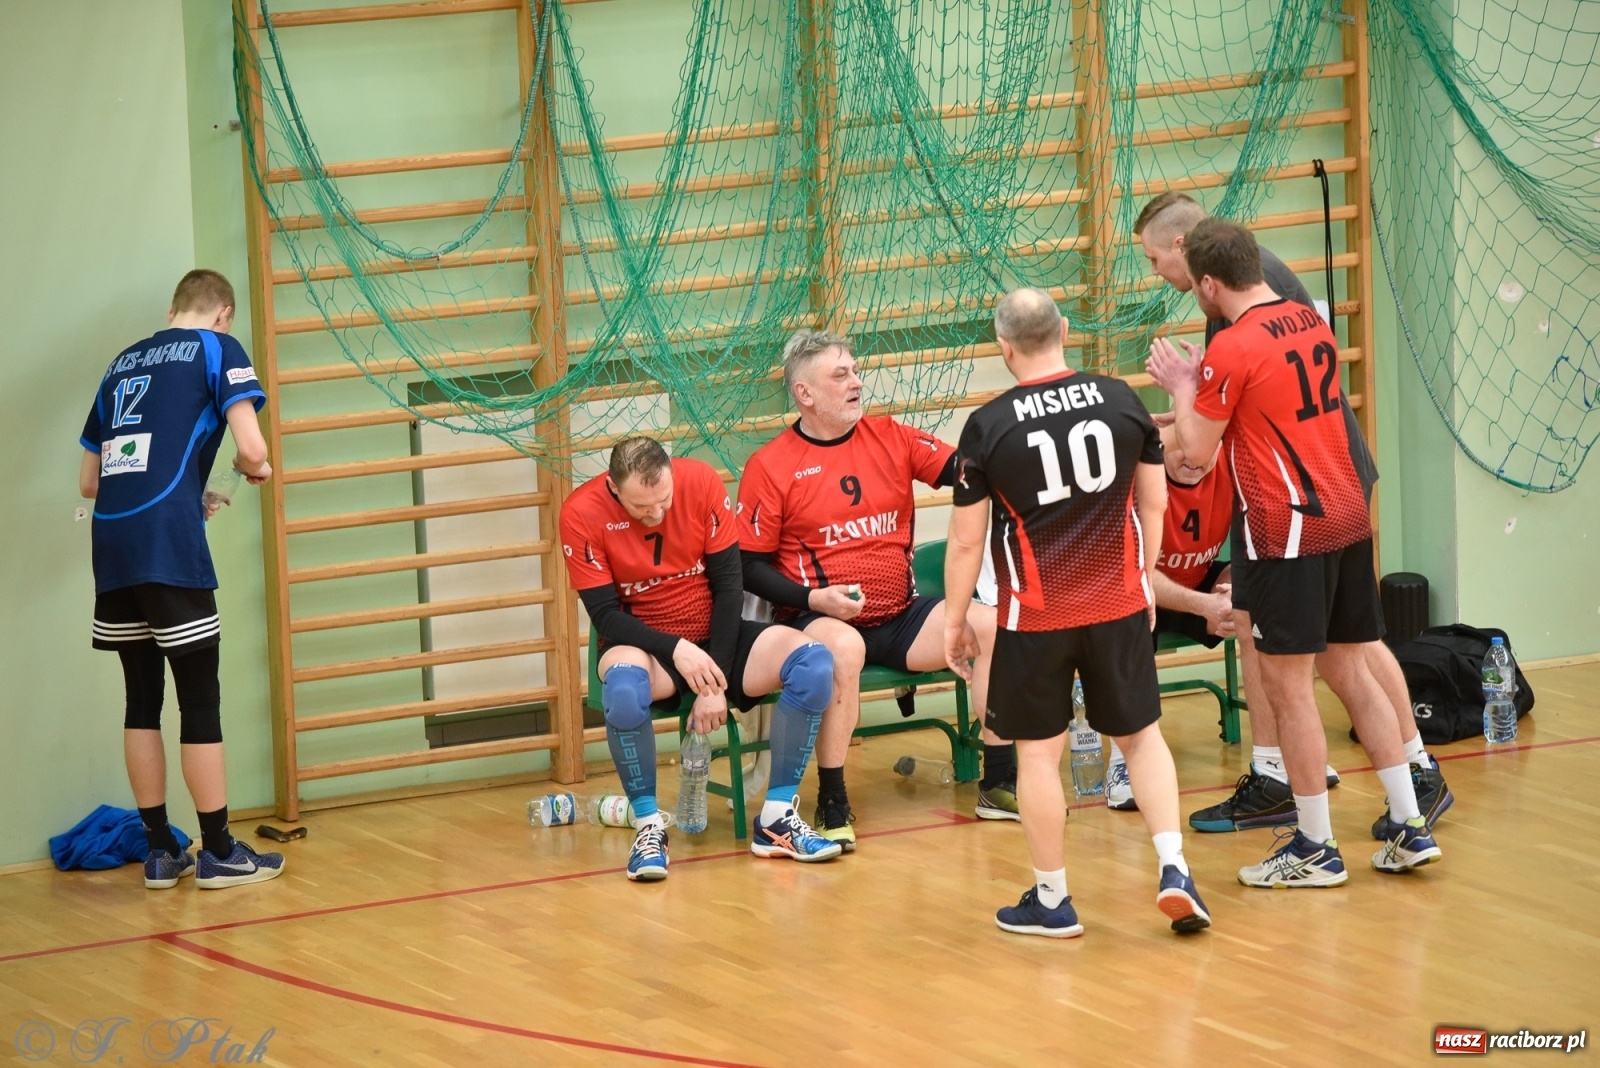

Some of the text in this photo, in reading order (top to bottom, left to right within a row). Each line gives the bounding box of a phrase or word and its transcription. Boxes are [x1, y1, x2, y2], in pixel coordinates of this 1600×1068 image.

[113, 341, 200, 374] AZS-RAFAKO
[1285, 340, 1340, 423] 12
[112, 374, 151, 429] 12
[1012, 381, 1105, 422] MISIEK
[1026, 419, 1117, 506] 10
[839, 474, 863, 507] 9
[818, 509, 899, 547] ZŁOTNIK
[1180, 508, 1201, 542] 4
[643, 531, 664, 567] 7
